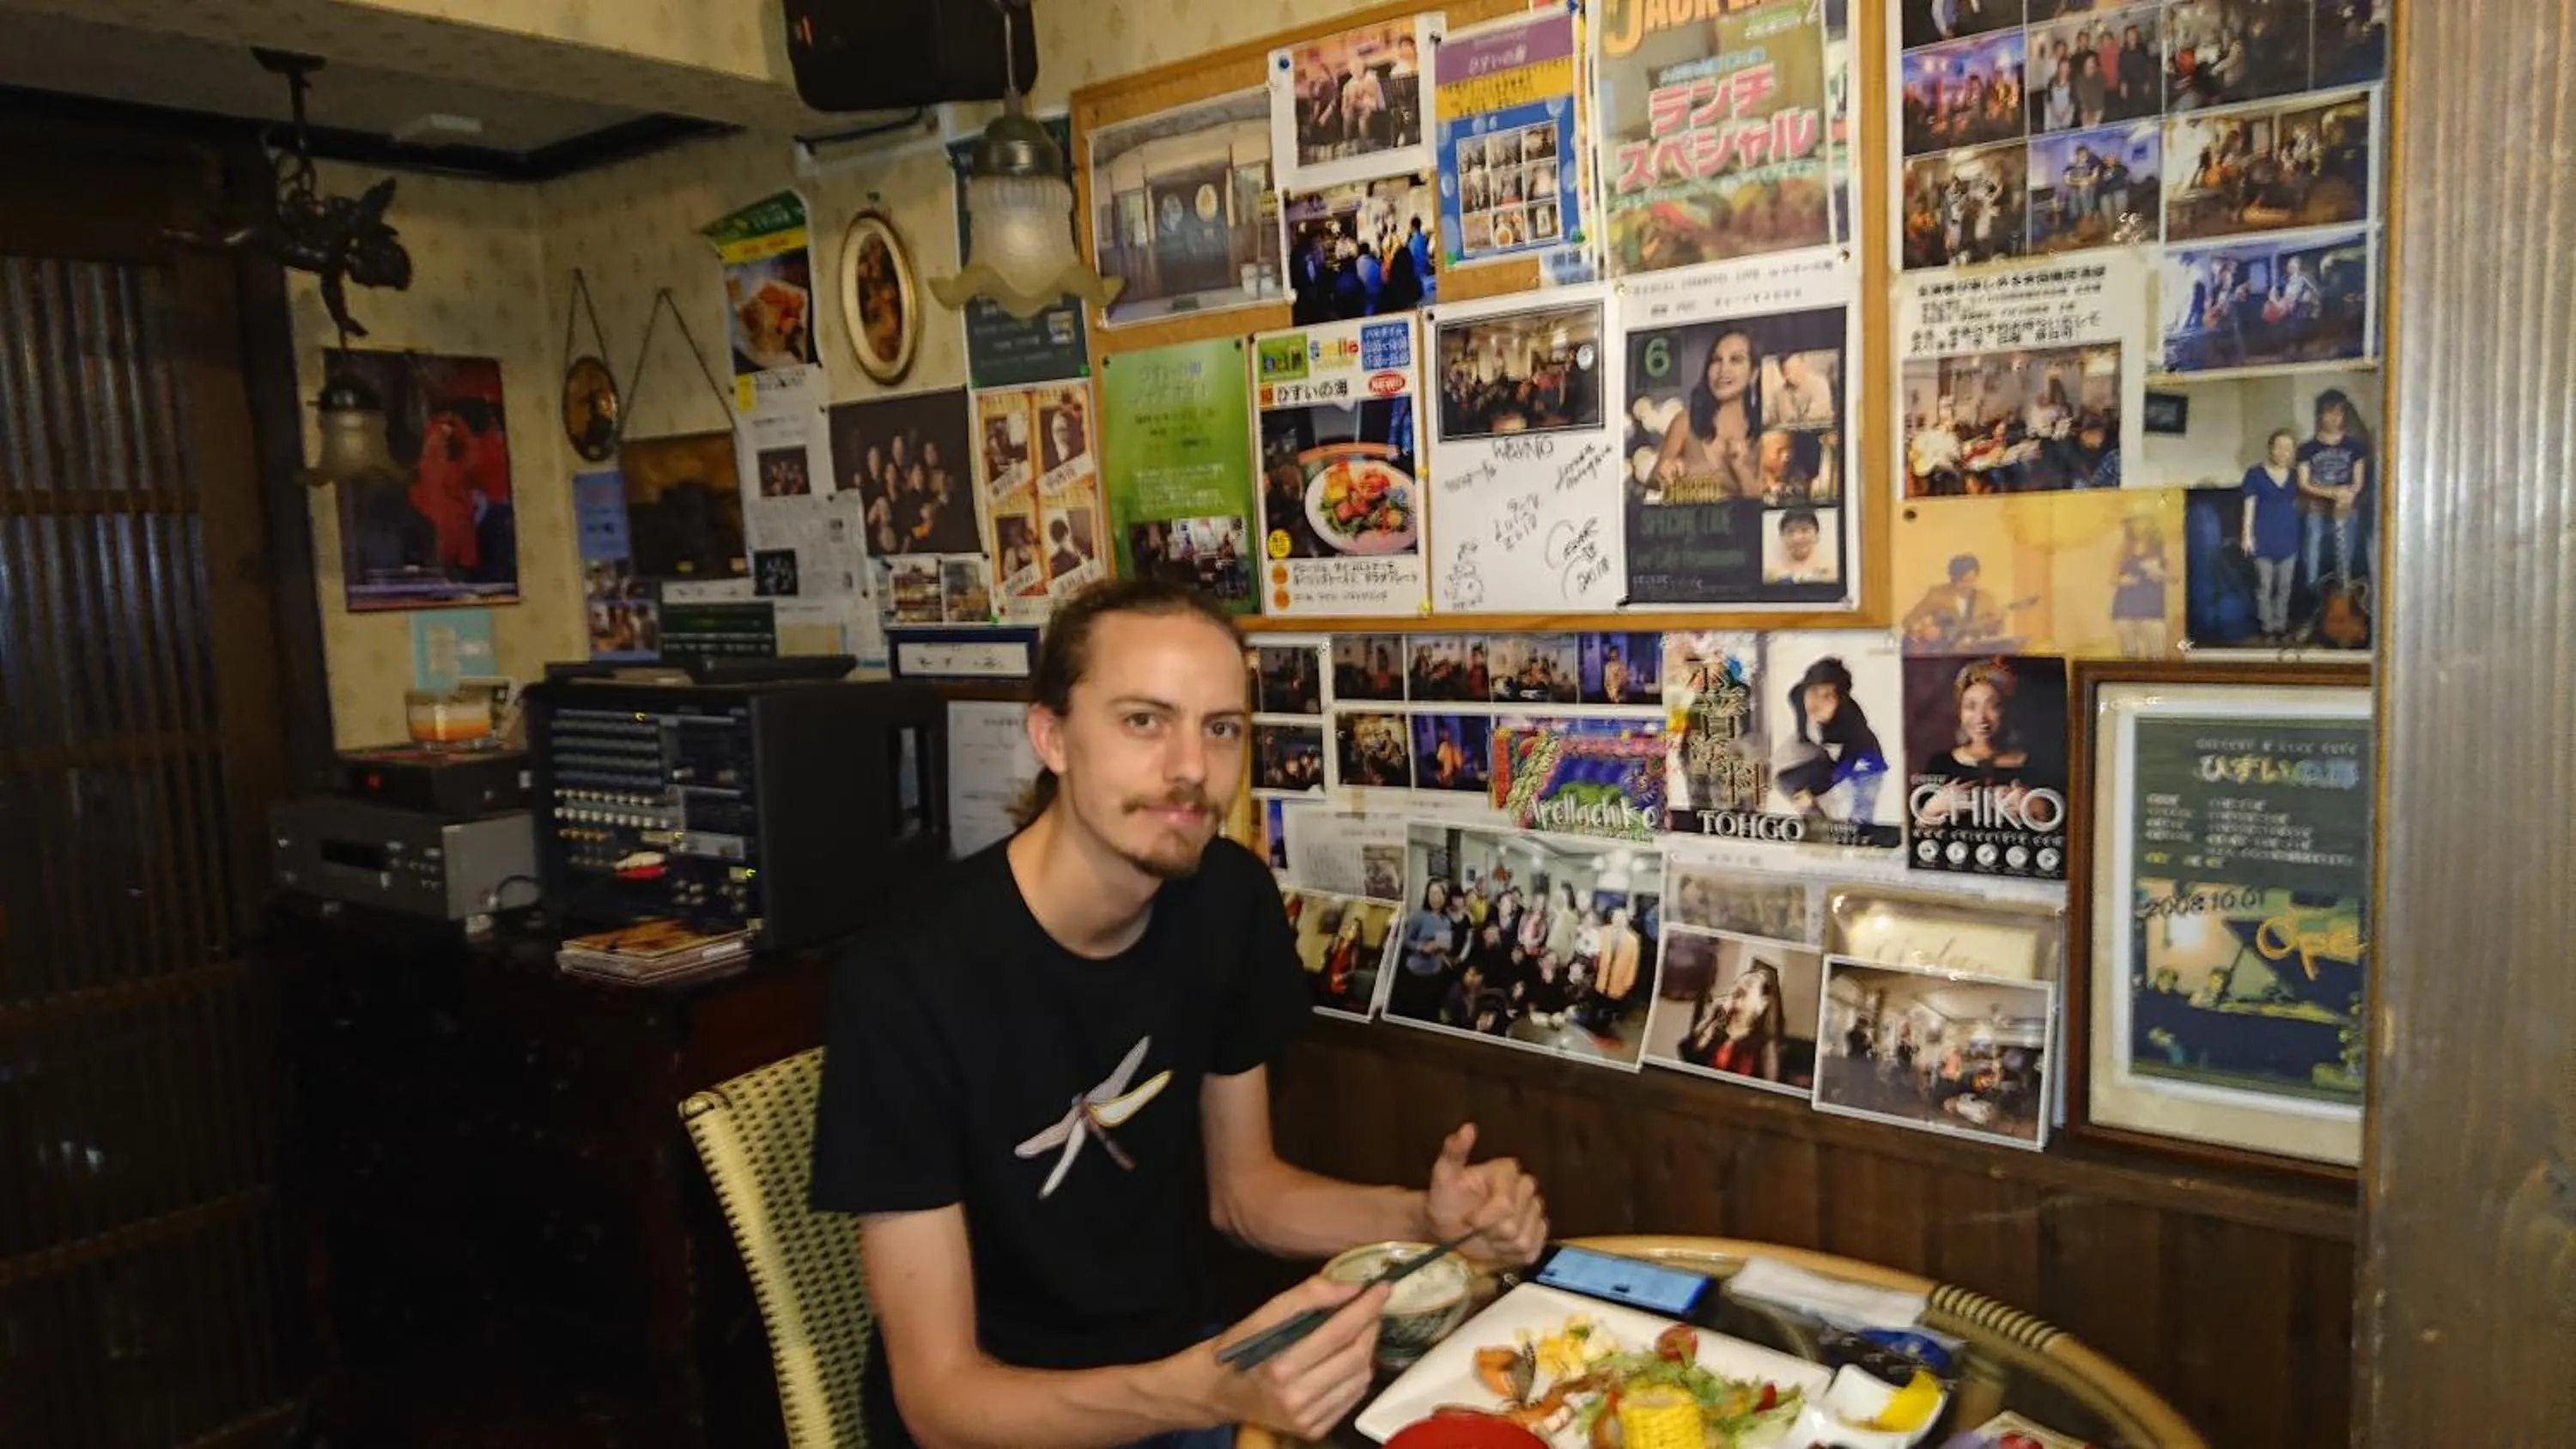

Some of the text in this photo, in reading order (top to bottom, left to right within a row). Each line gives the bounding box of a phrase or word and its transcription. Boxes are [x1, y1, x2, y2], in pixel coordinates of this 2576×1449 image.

[1649, 63, 1775, 137] ランチ
[1616, 107, 1819, 195] スペシャル
[1644, 337, 1672, 377] 6
[1696, 809, 1805, 842] TOHGO
[1910, 783, 2065, 832] CHIKO
